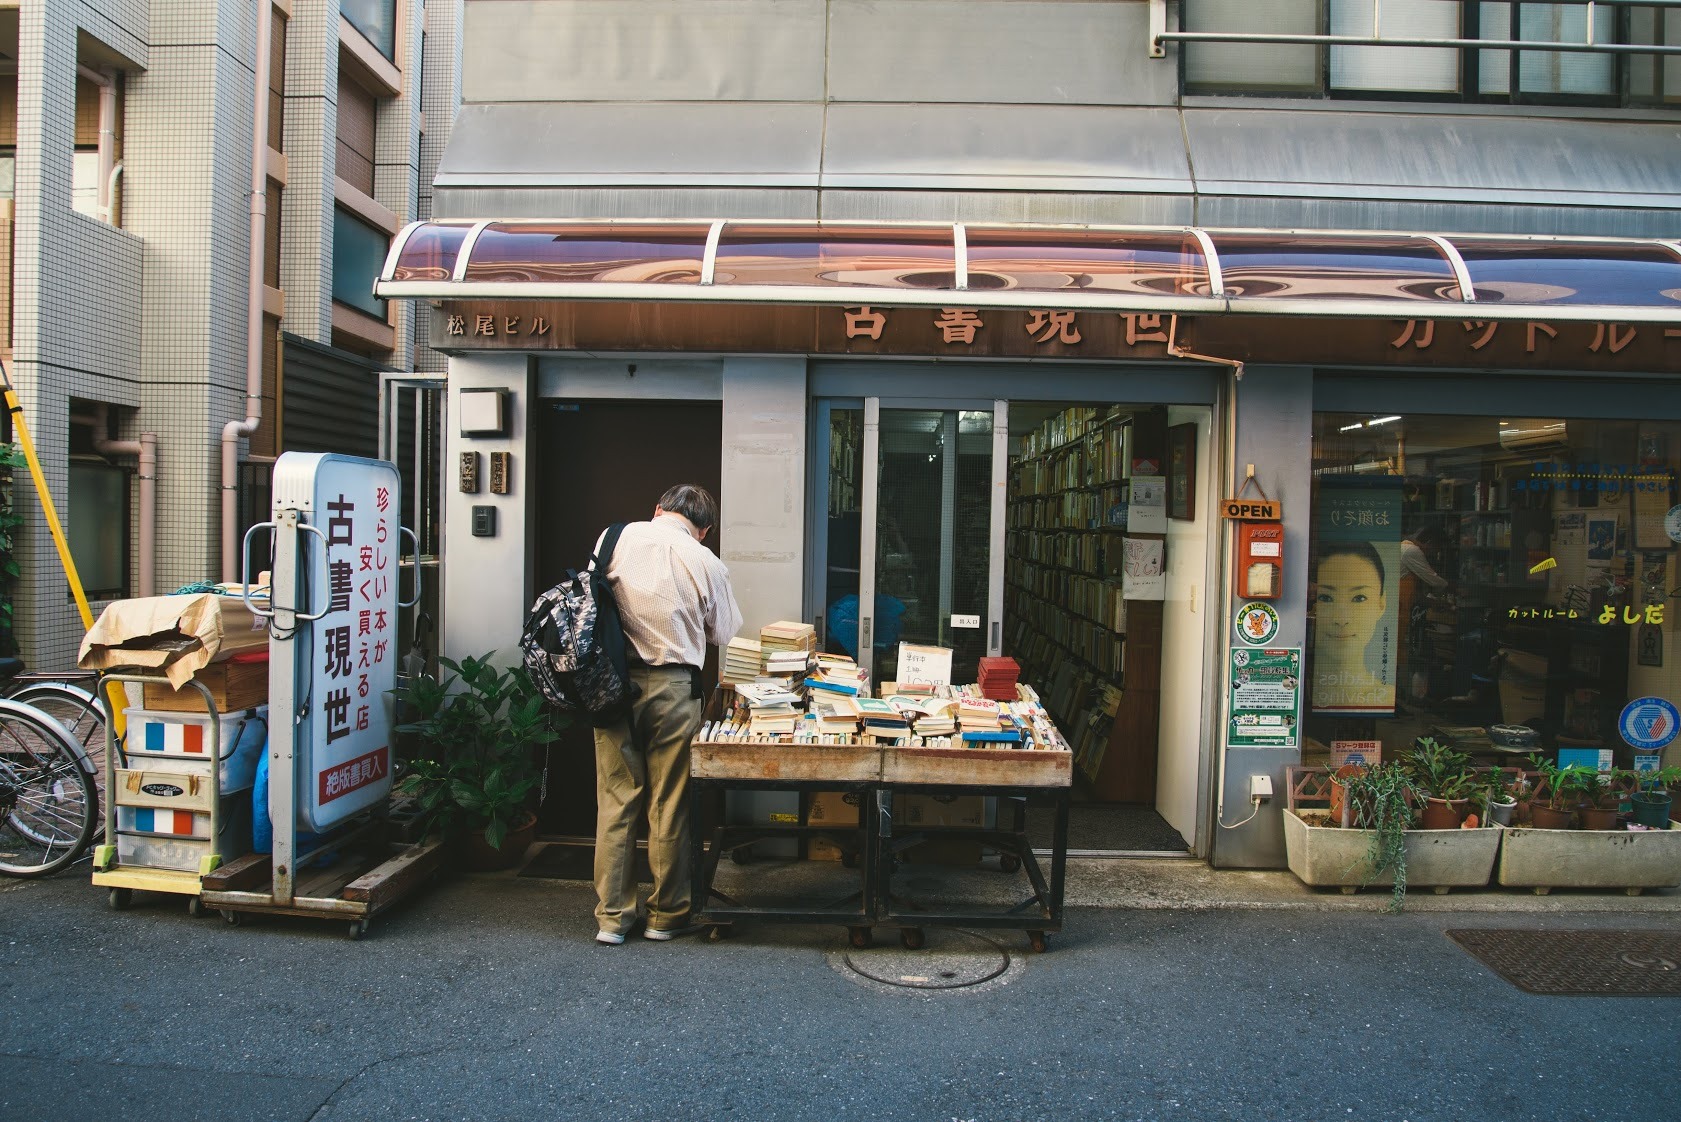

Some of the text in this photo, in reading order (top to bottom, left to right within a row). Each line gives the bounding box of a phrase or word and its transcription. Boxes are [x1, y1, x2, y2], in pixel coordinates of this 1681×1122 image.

[446, 314, 552, 336] 松尾ビル
[1228, 504, 1272, 518] OPEN
[374, 487, 389, 664] 珍らしい本が
[324, 493, 355, 746] 古書現世
[1508, 603, 1665, 625] カットルーム よしだ
[357, 545, 373, 731] 安く買える店
[325, 755, 383, 797] 絶版書買入
